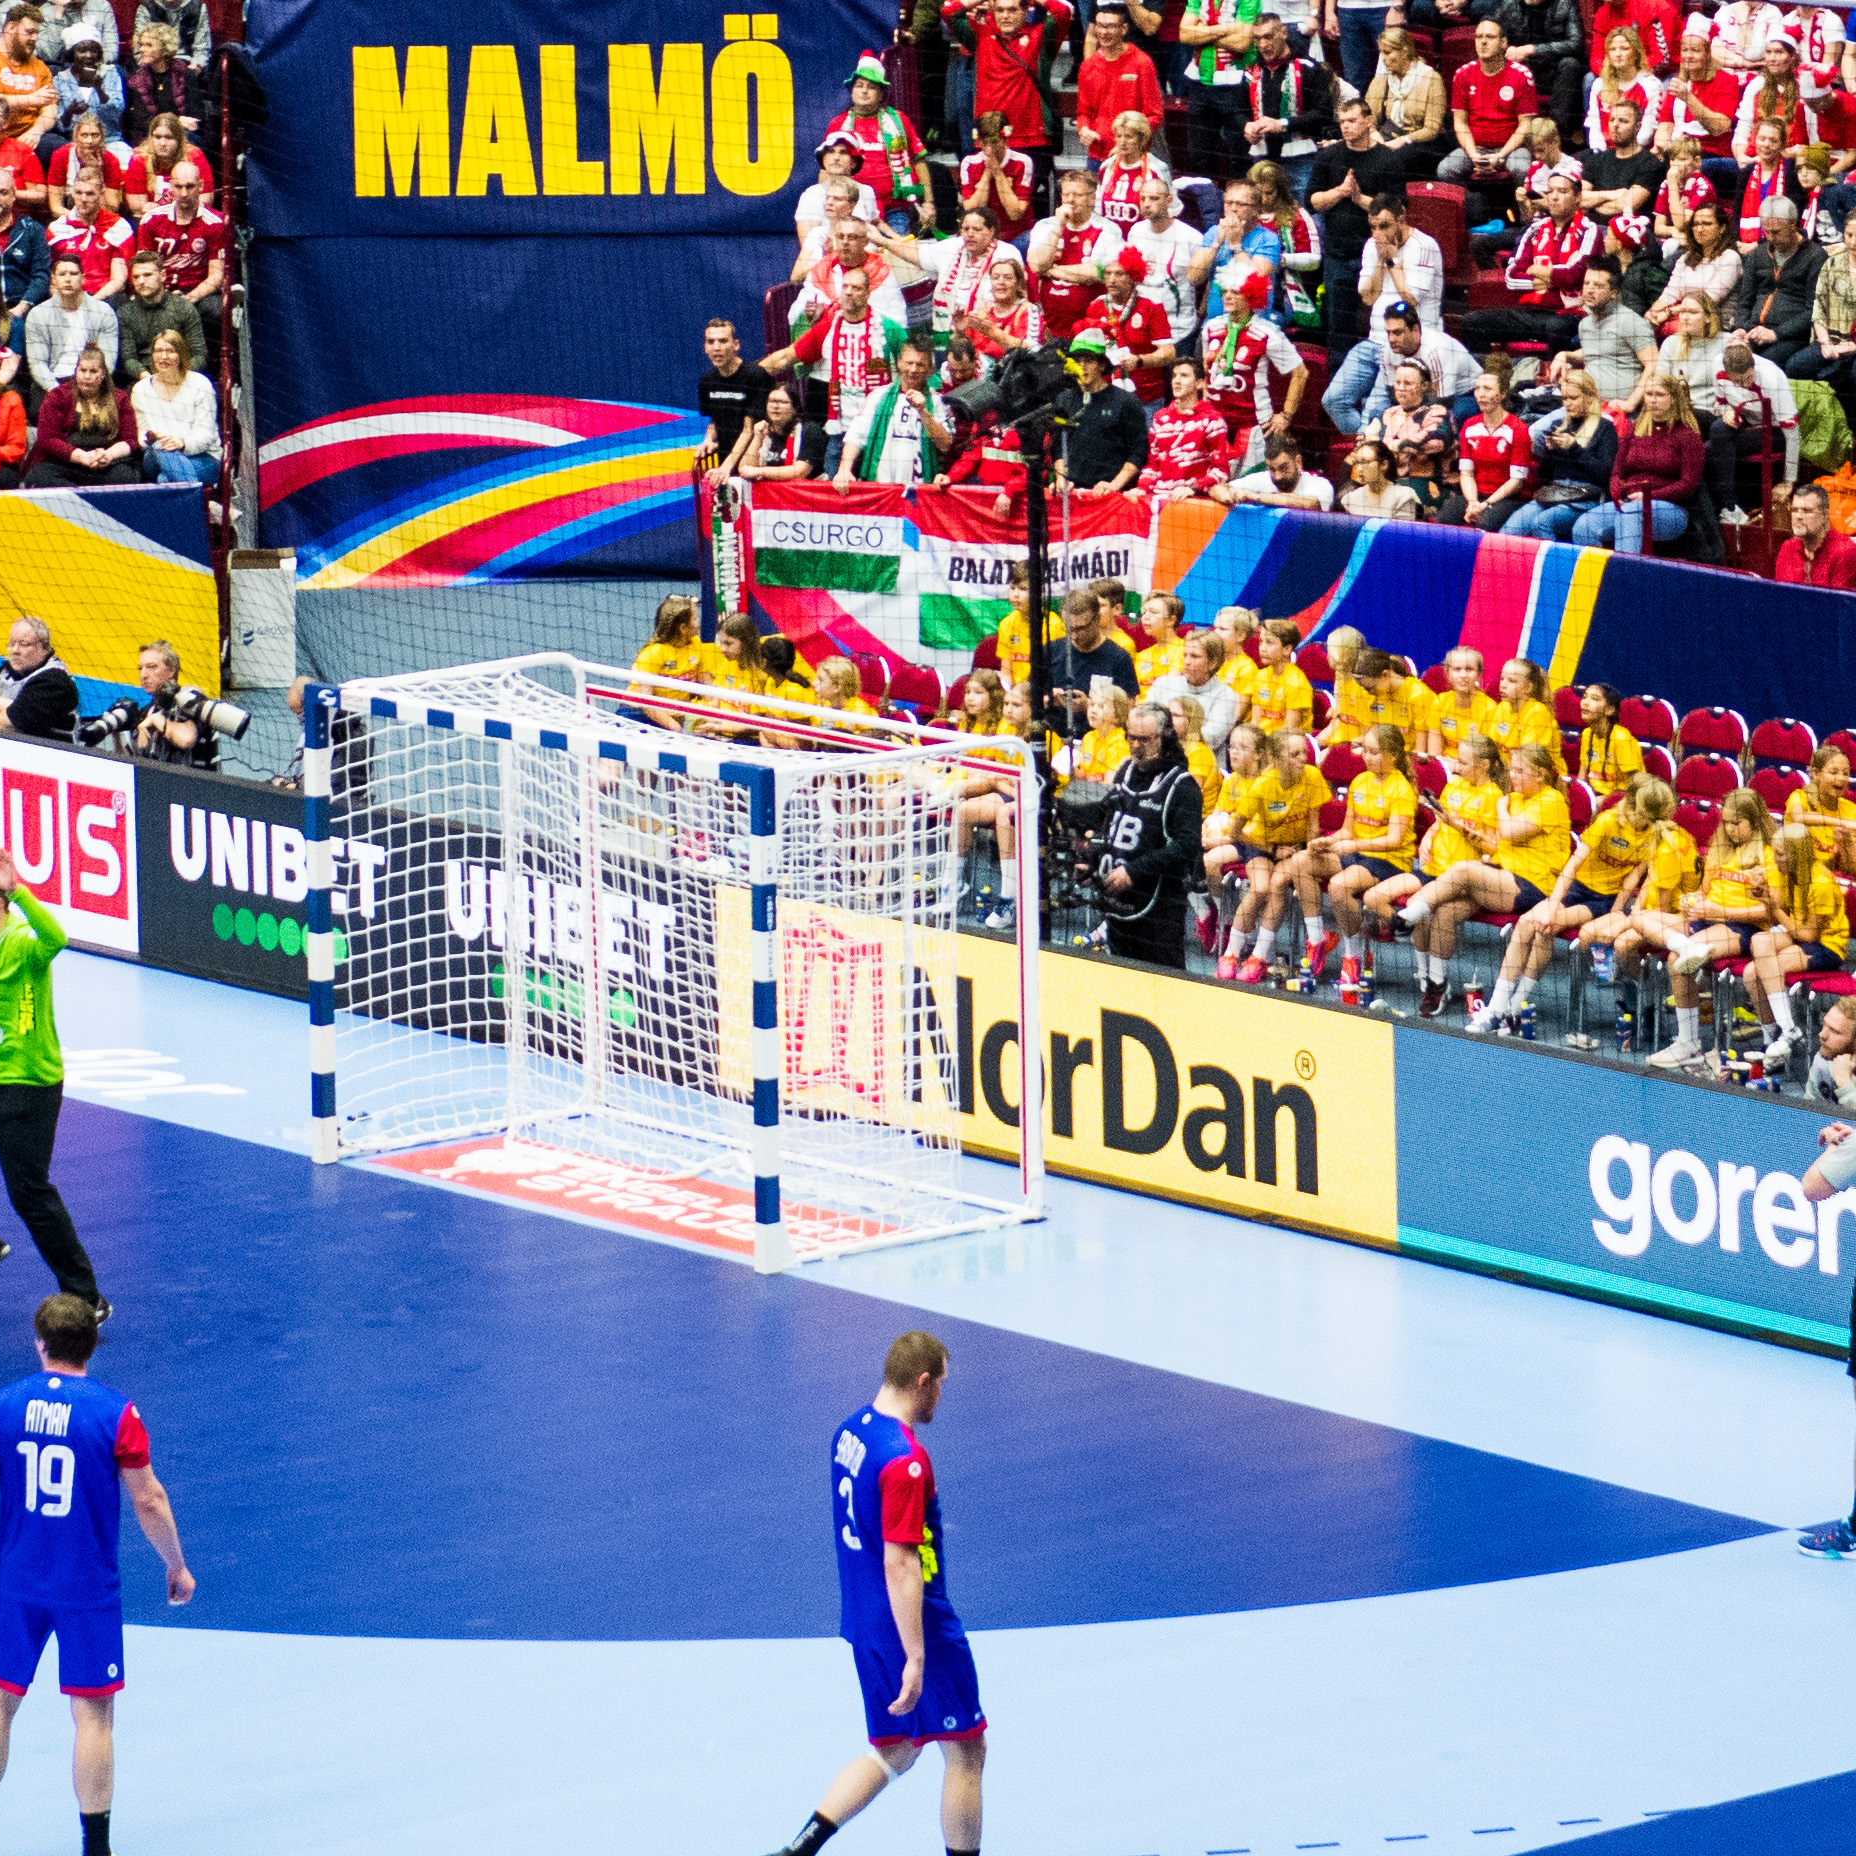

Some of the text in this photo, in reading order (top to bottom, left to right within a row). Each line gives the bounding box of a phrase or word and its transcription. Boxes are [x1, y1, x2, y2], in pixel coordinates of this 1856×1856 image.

[353, 13, 795, 198] MALMÖ
[772, 519, 884, 549] CSURGÓ
[947, 546, 1130, 585] BALATALMÁDI
[25, 1399, 72, 1438] ATMAN
[16, 1441, 75, 1517] 19
